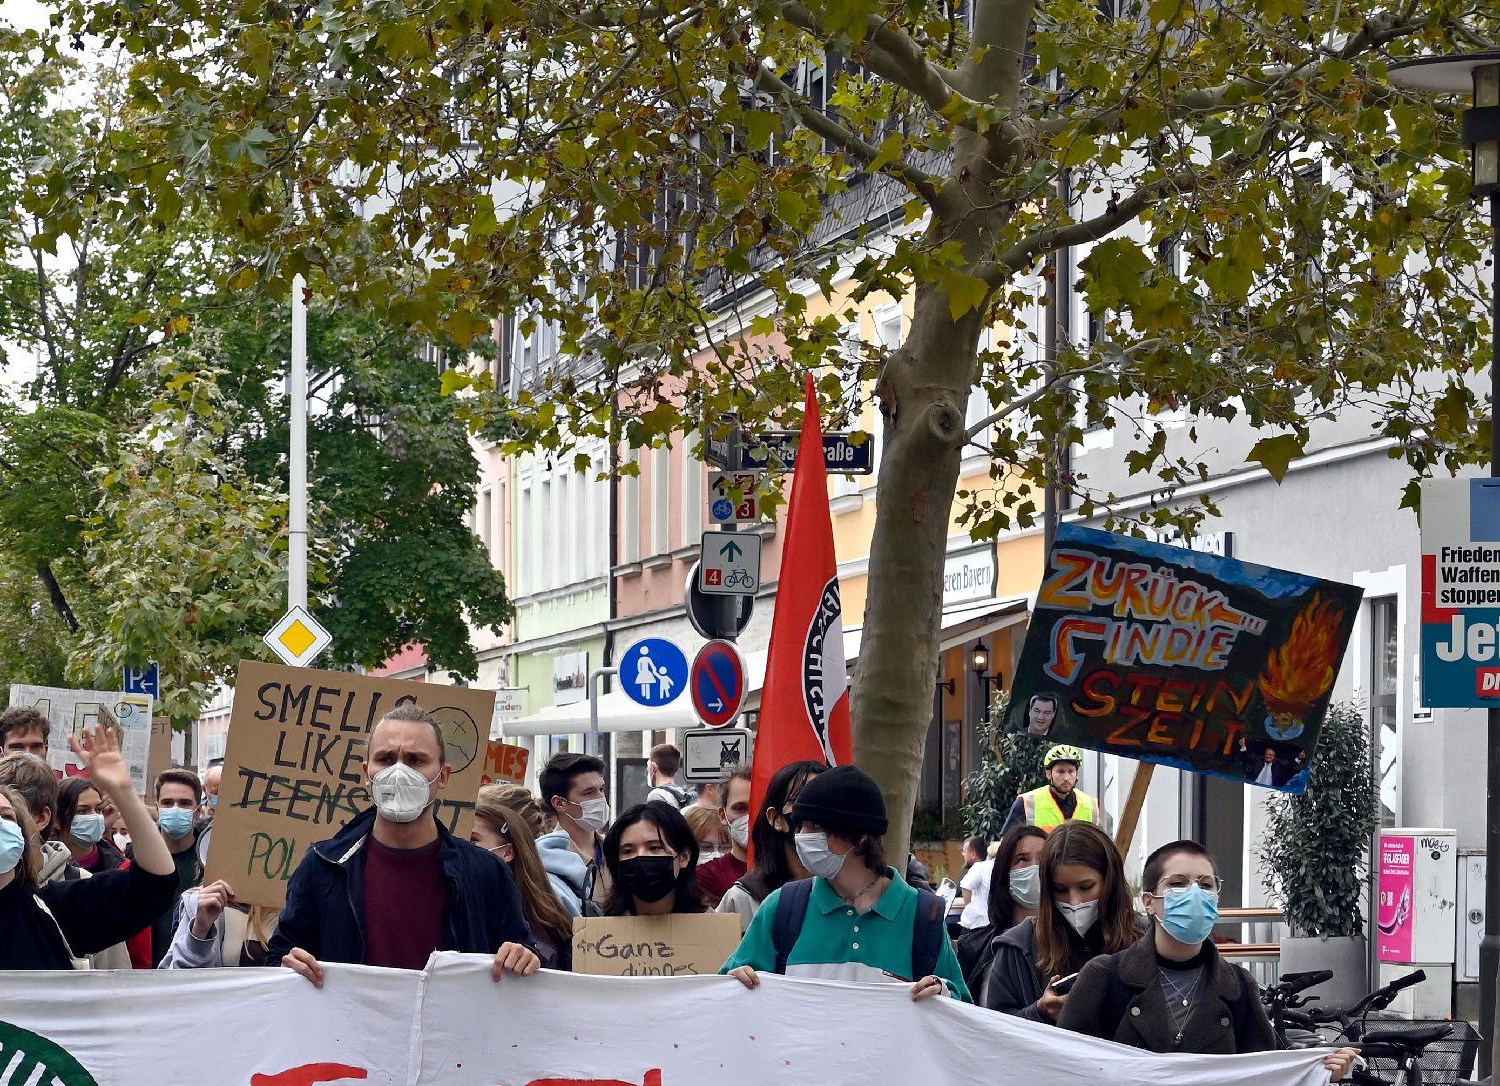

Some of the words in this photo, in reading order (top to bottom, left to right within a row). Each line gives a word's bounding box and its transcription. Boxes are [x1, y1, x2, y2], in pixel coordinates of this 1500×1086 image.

[741, 504, 749, 516] 3
[709, 571, 717, 583] 4
[964, 565, 990, 594] Bayern
[1036, 549, 1220, 626] ZURÜCK
[1072, 669, 1255, 717] STEIN
[1107, 706, 1248, 756] ZEIT
[275, 731, 368, 784] LIKE
[597, 934, 675, 959] Ganz
